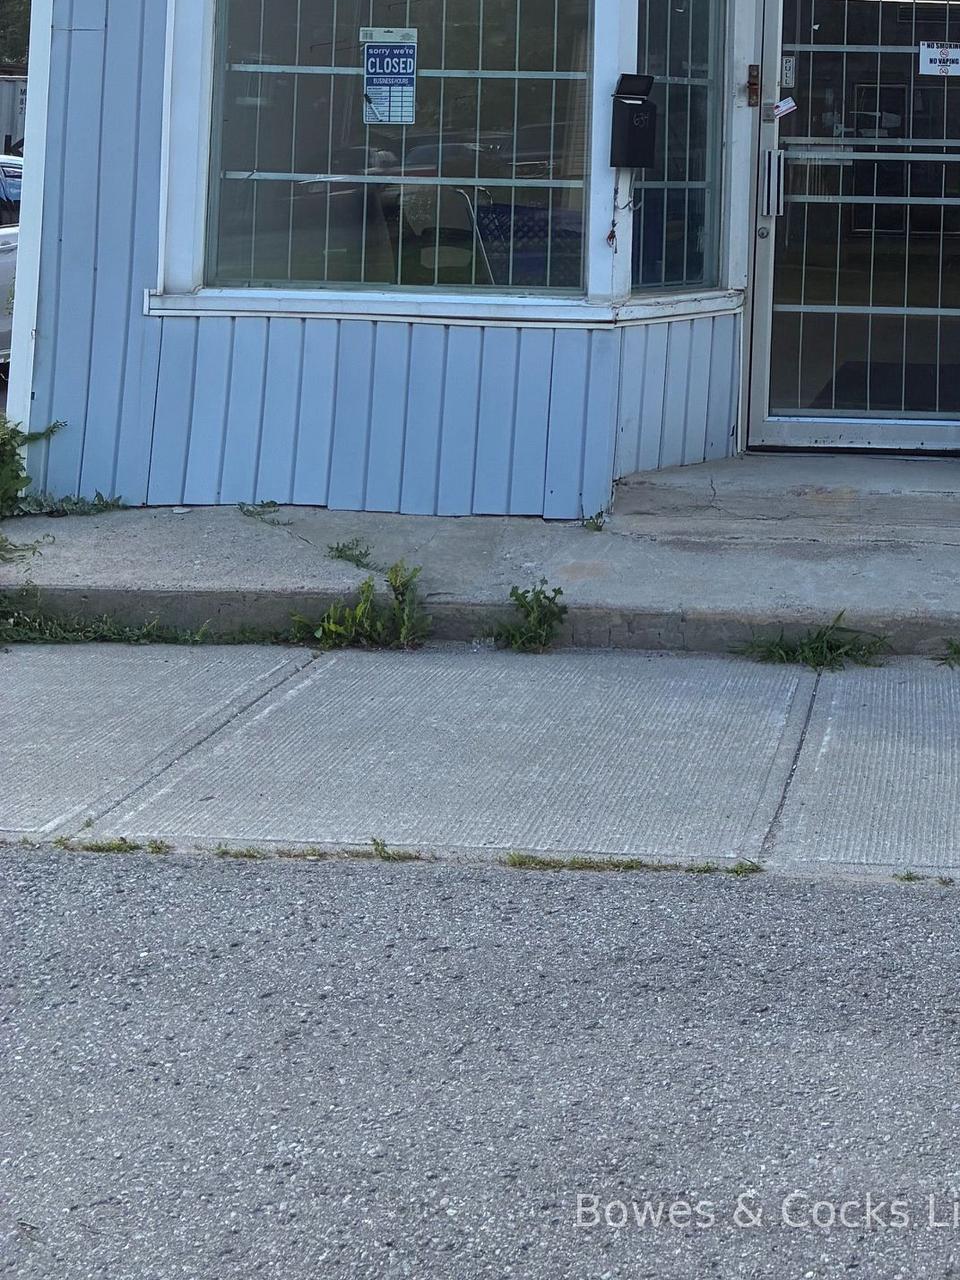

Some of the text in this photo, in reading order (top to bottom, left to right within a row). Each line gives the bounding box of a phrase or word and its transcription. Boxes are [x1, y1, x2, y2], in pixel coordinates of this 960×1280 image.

[368, 48, 390, 56] sorry
[367, 57, 414, 73] CLOSED
[929, 57, 959, 65] NO VAPING
[784, 58, 792, 85] PULL
